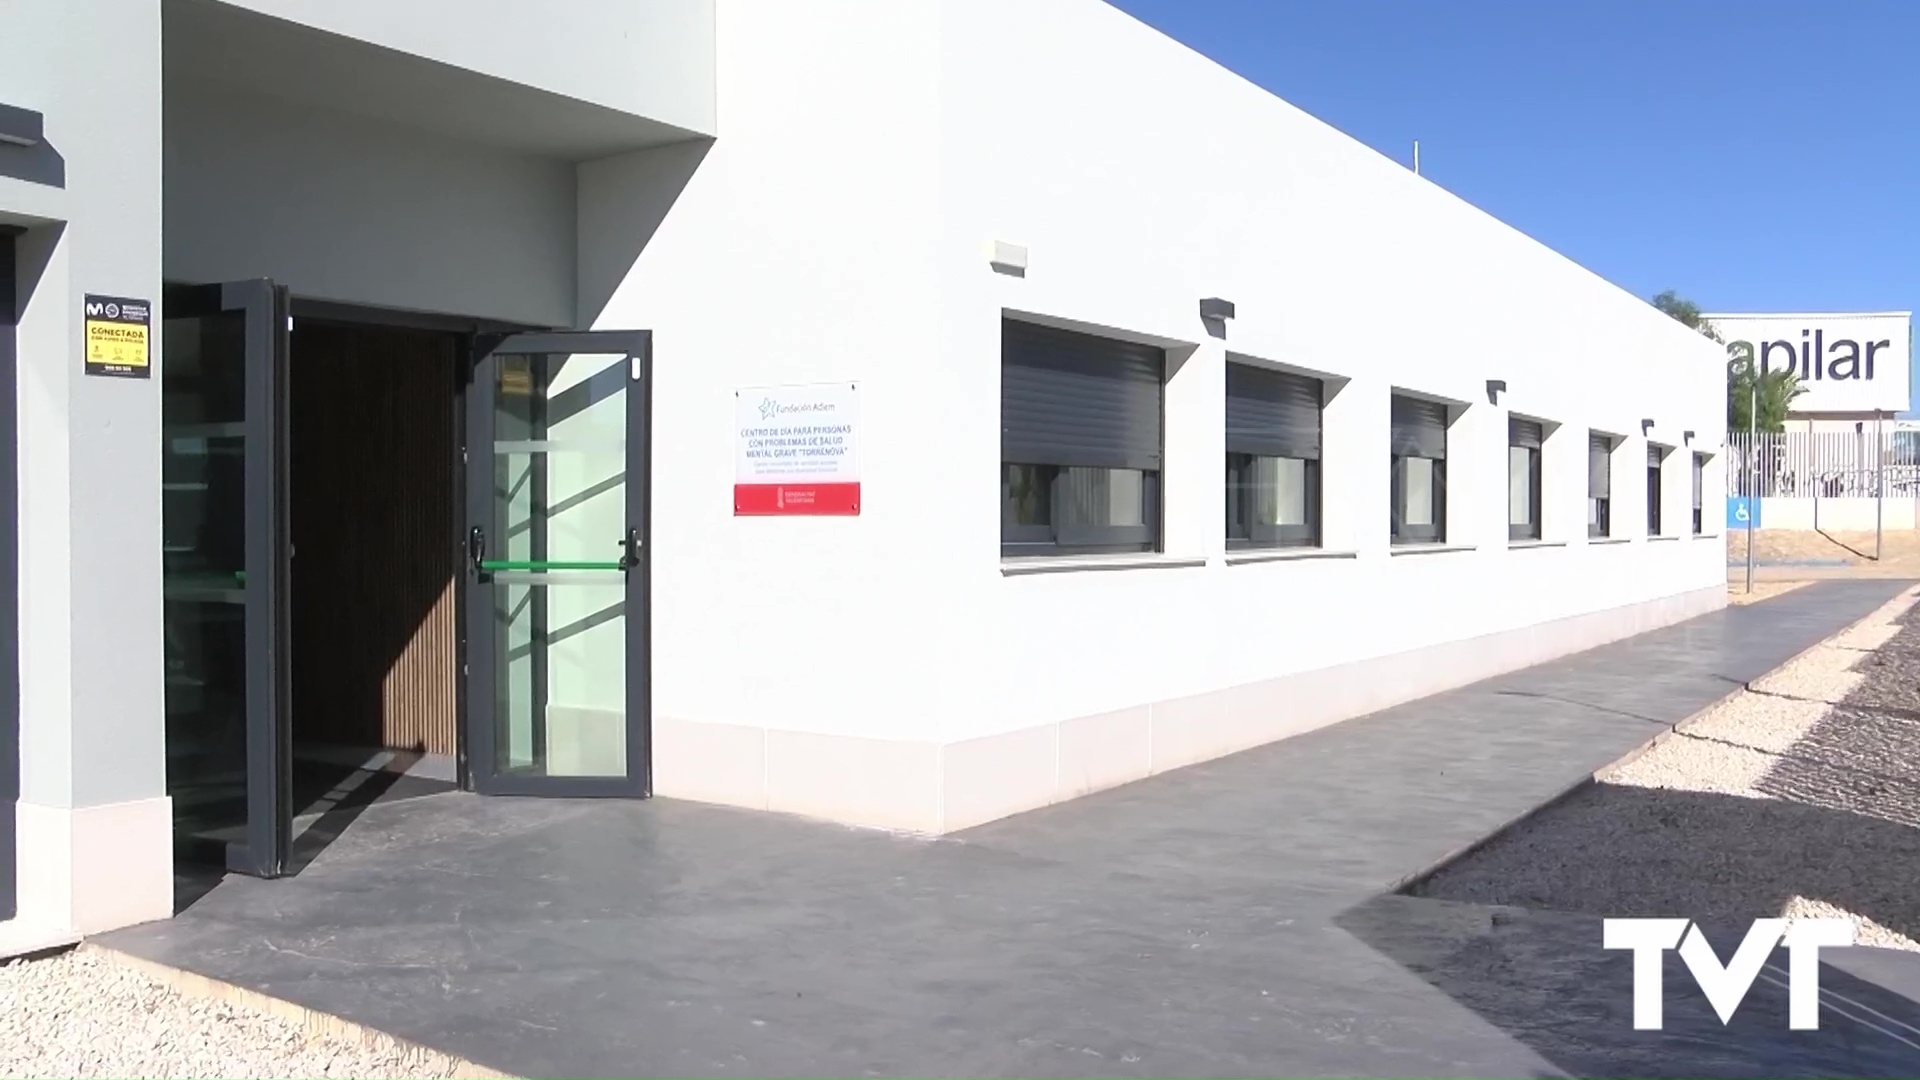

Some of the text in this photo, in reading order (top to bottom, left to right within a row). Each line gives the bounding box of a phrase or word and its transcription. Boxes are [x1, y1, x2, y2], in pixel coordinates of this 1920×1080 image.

[91, 327, 144, 338] CONECTADA
[1727, 329, 1890, 381] apilar
[740, 425, 852, 438] CENTRO DE DÍA PARA PERSONAS
[748, 436, 844, 448] CON PROBLEMAS DE SALUD
[746, 449, 772, 458] MENTAL
[773, 448, 797, 457] GRAVE
